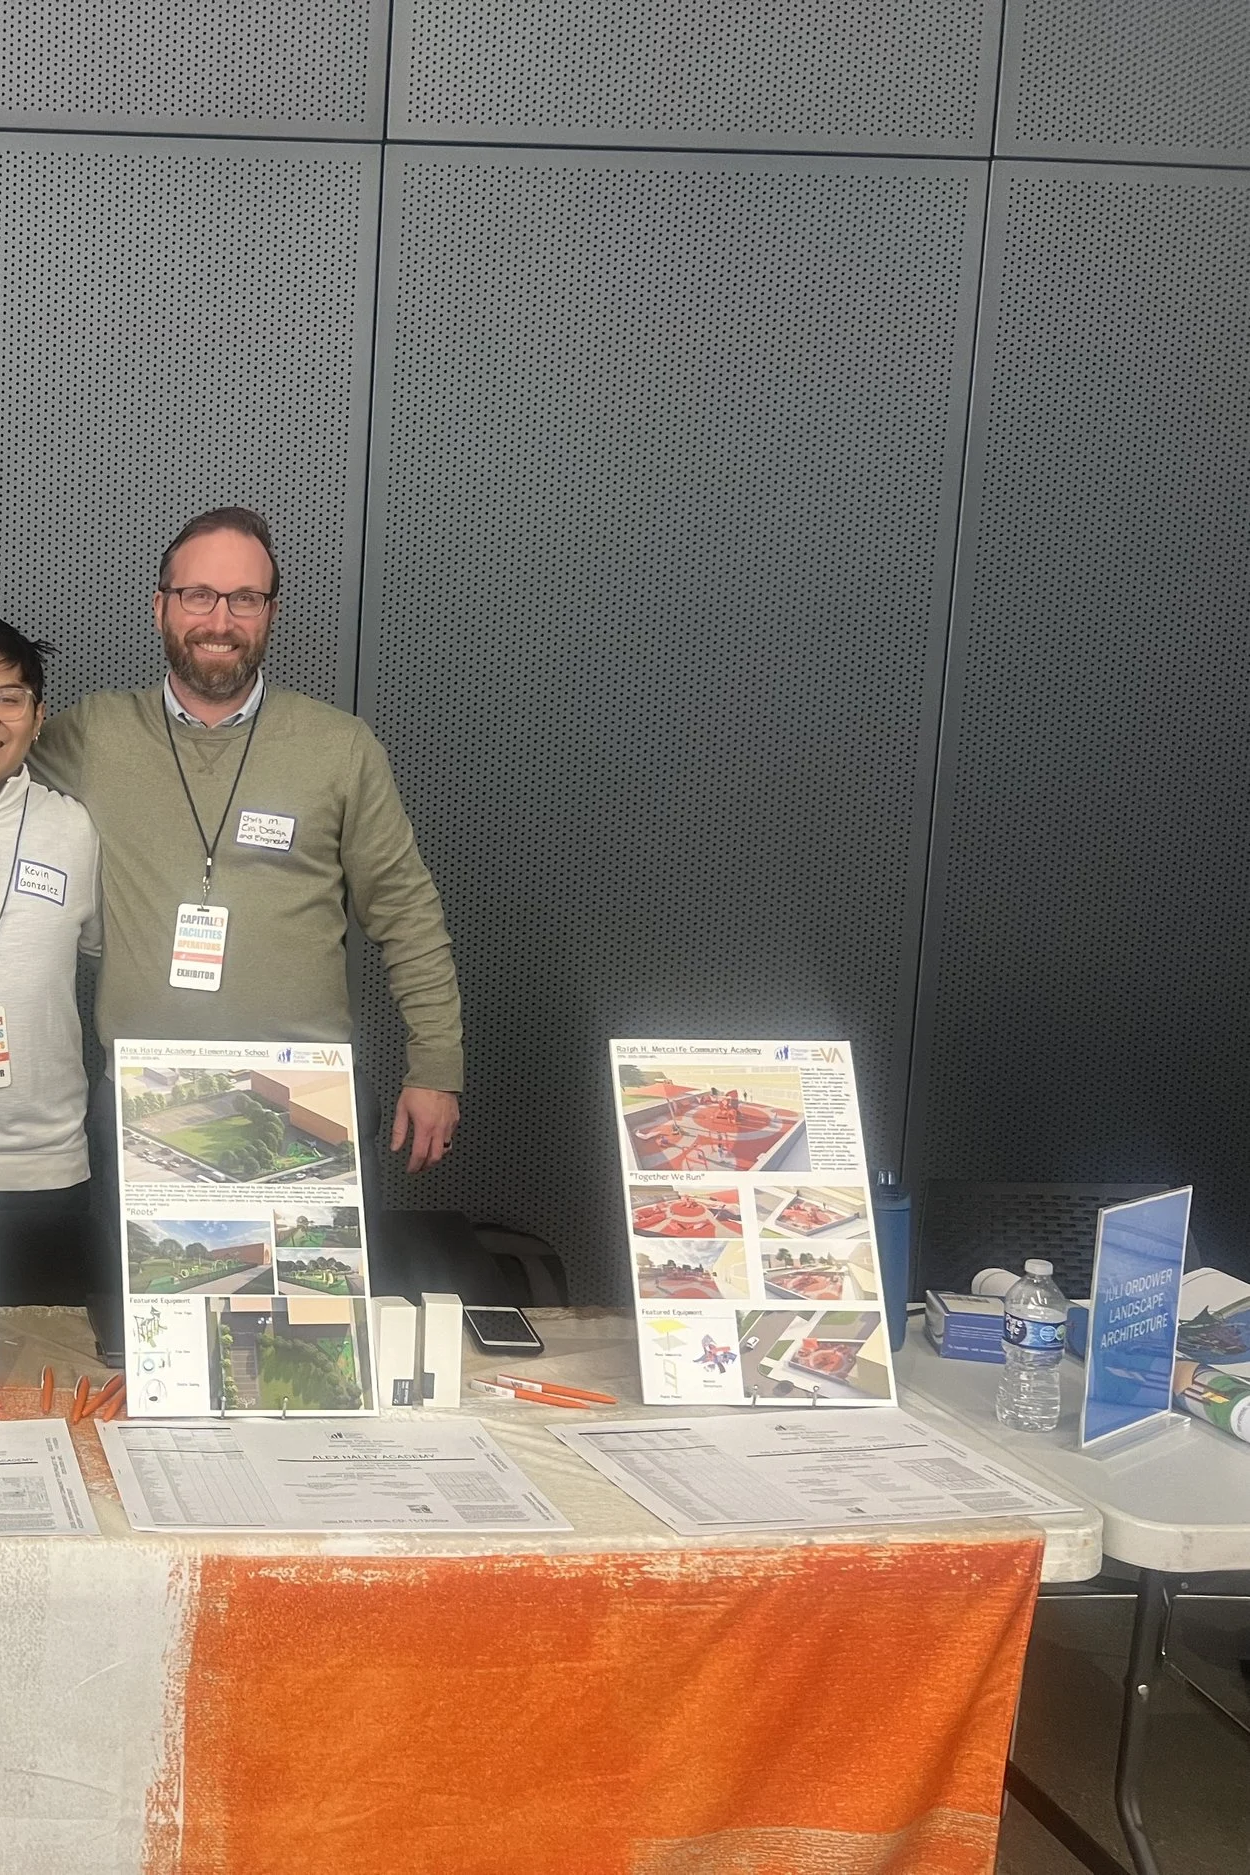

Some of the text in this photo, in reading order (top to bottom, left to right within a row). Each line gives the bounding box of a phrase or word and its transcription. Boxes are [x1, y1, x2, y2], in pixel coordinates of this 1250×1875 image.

[25, 865, 49, 880] Kevin
[179, 927, 222, 940] FACILITIES
[177, 968, 215, 980] EXHIBITOR
[120, 1046, 138, 1054] Alex
[165, 1047, 196, 1056] Academy
[199, 1048, 241, 1057] Elementary
[245, 1049, 269, 1057] School
[312, 1050, 345, 1066] EVA
[616, 1046, 639, 1055] Ralph
[652, 1046, 687, 1054] Metcalfe
[689, 1046, 728, 1056] Community
[731, 1047, 762, 1056] Academy
[810, 1047, 844, 1063] EVA
[671, 1173, 685, 1181] We
[1104, 1268, 1173, 1304] JULI ORDOWER
[161, 1297, 191, 1305] Equipment
[1109, 1292, 1164, 1324] LANDSCAPE
[1101, 1312, 1169, 1348] ARCHITECTURE
